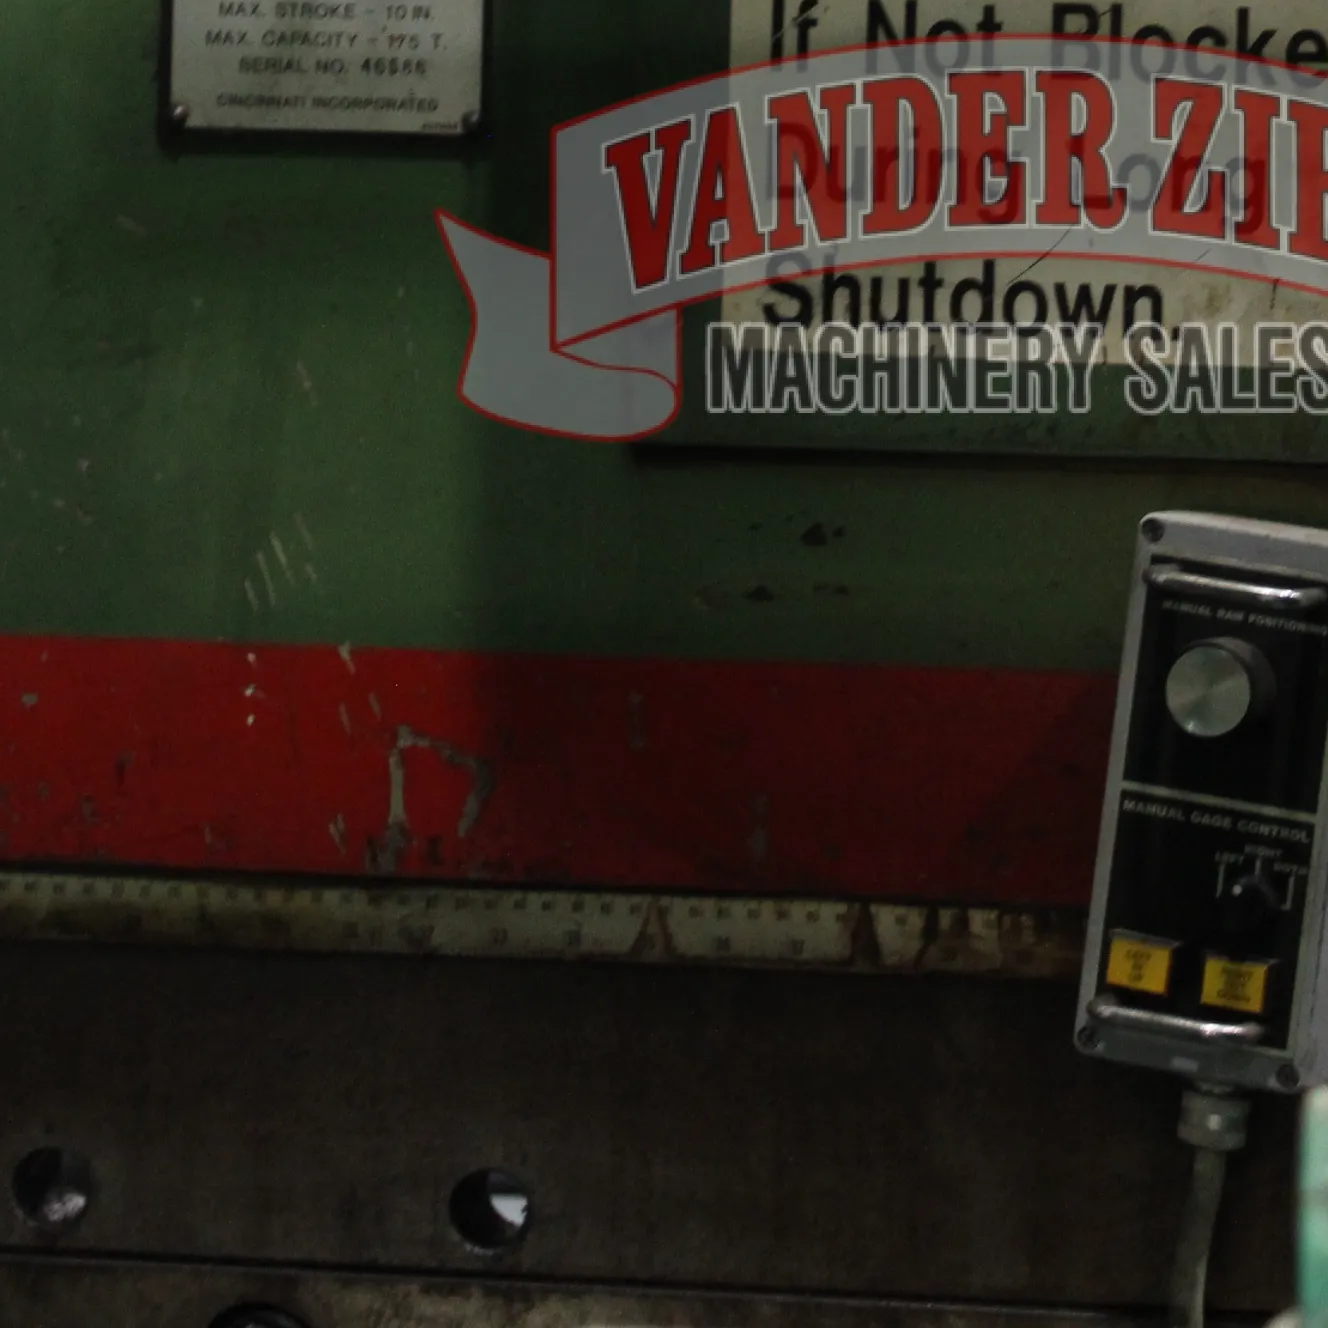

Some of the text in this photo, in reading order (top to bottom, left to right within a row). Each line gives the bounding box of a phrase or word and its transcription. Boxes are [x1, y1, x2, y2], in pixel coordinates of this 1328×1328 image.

[274, 1, 356, 19] STROKE
[386, 4, 408, 21] 10
[261, 29, 358, 49] CAPACITY
[238, 56, 308, 74] SERIAL
[216, 92, 439, 112] CINCINNATI INCORPORATED
[1162, 599, 1212, 618] MANUAL
[1123, 799, 1311, 844] MANUAL GAGE CONTROL
